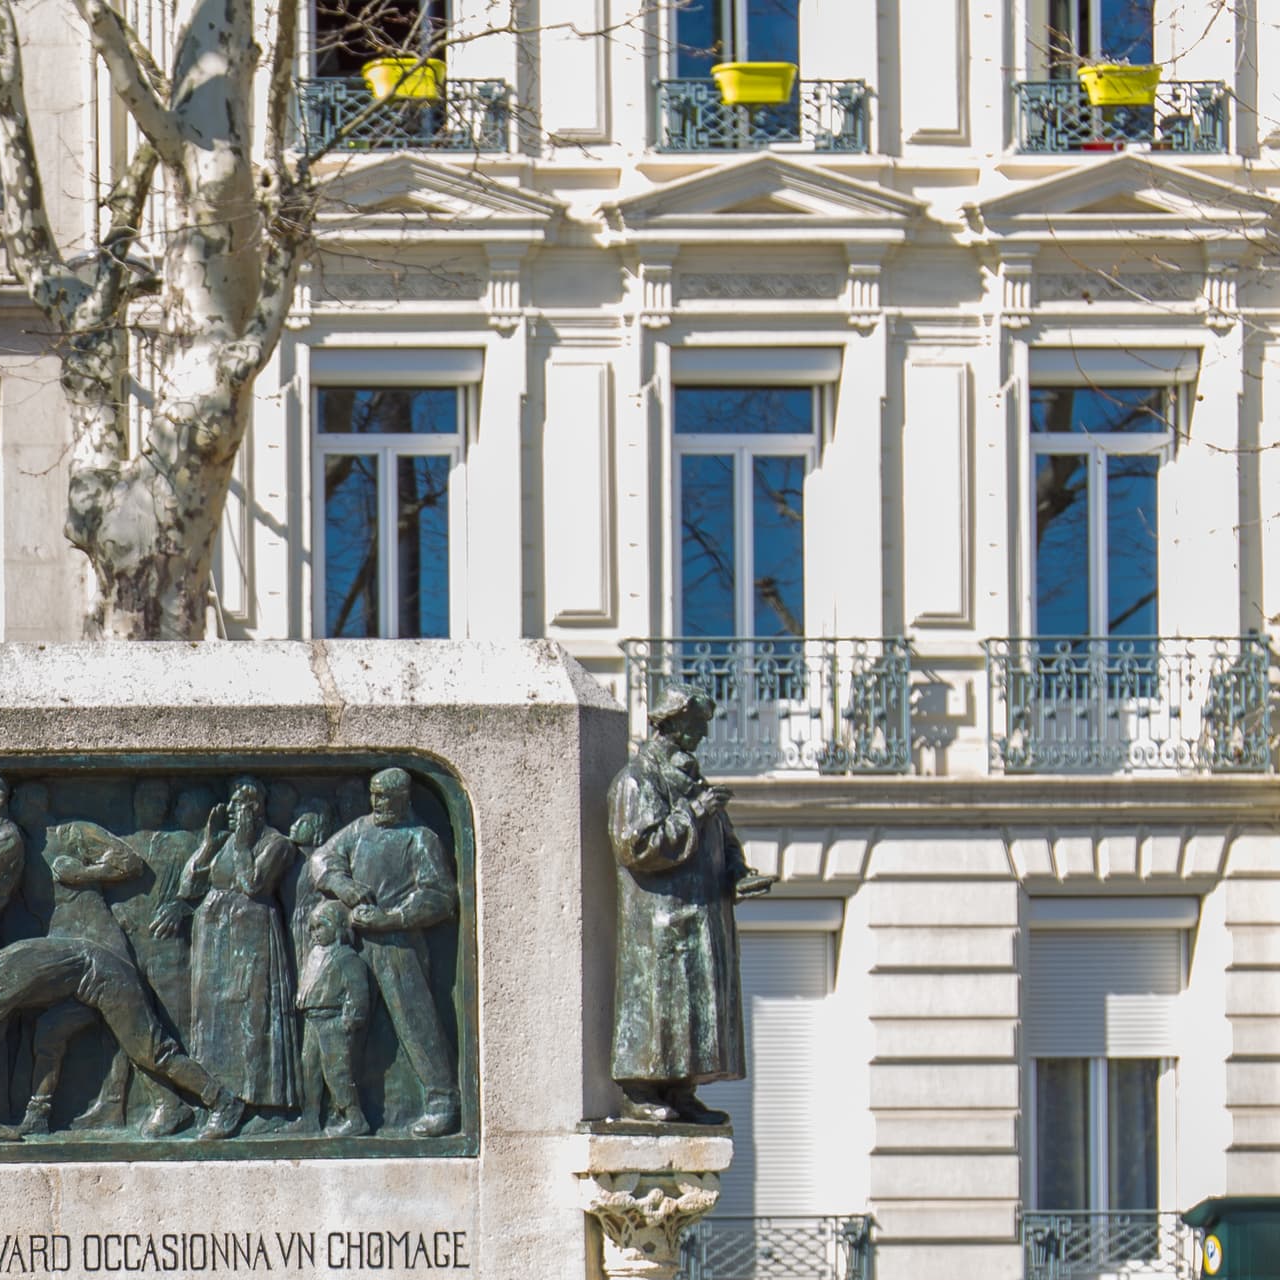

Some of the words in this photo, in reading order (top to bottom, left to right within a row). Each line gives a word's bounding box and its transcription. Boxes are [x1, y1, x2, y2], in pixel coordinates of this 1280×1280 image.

[83, 1232, 273, 1273] OCCASIONNA
[275, 1232, 315, 1270] VN
[327, 1230, 470, 1270] CHOMAGE
